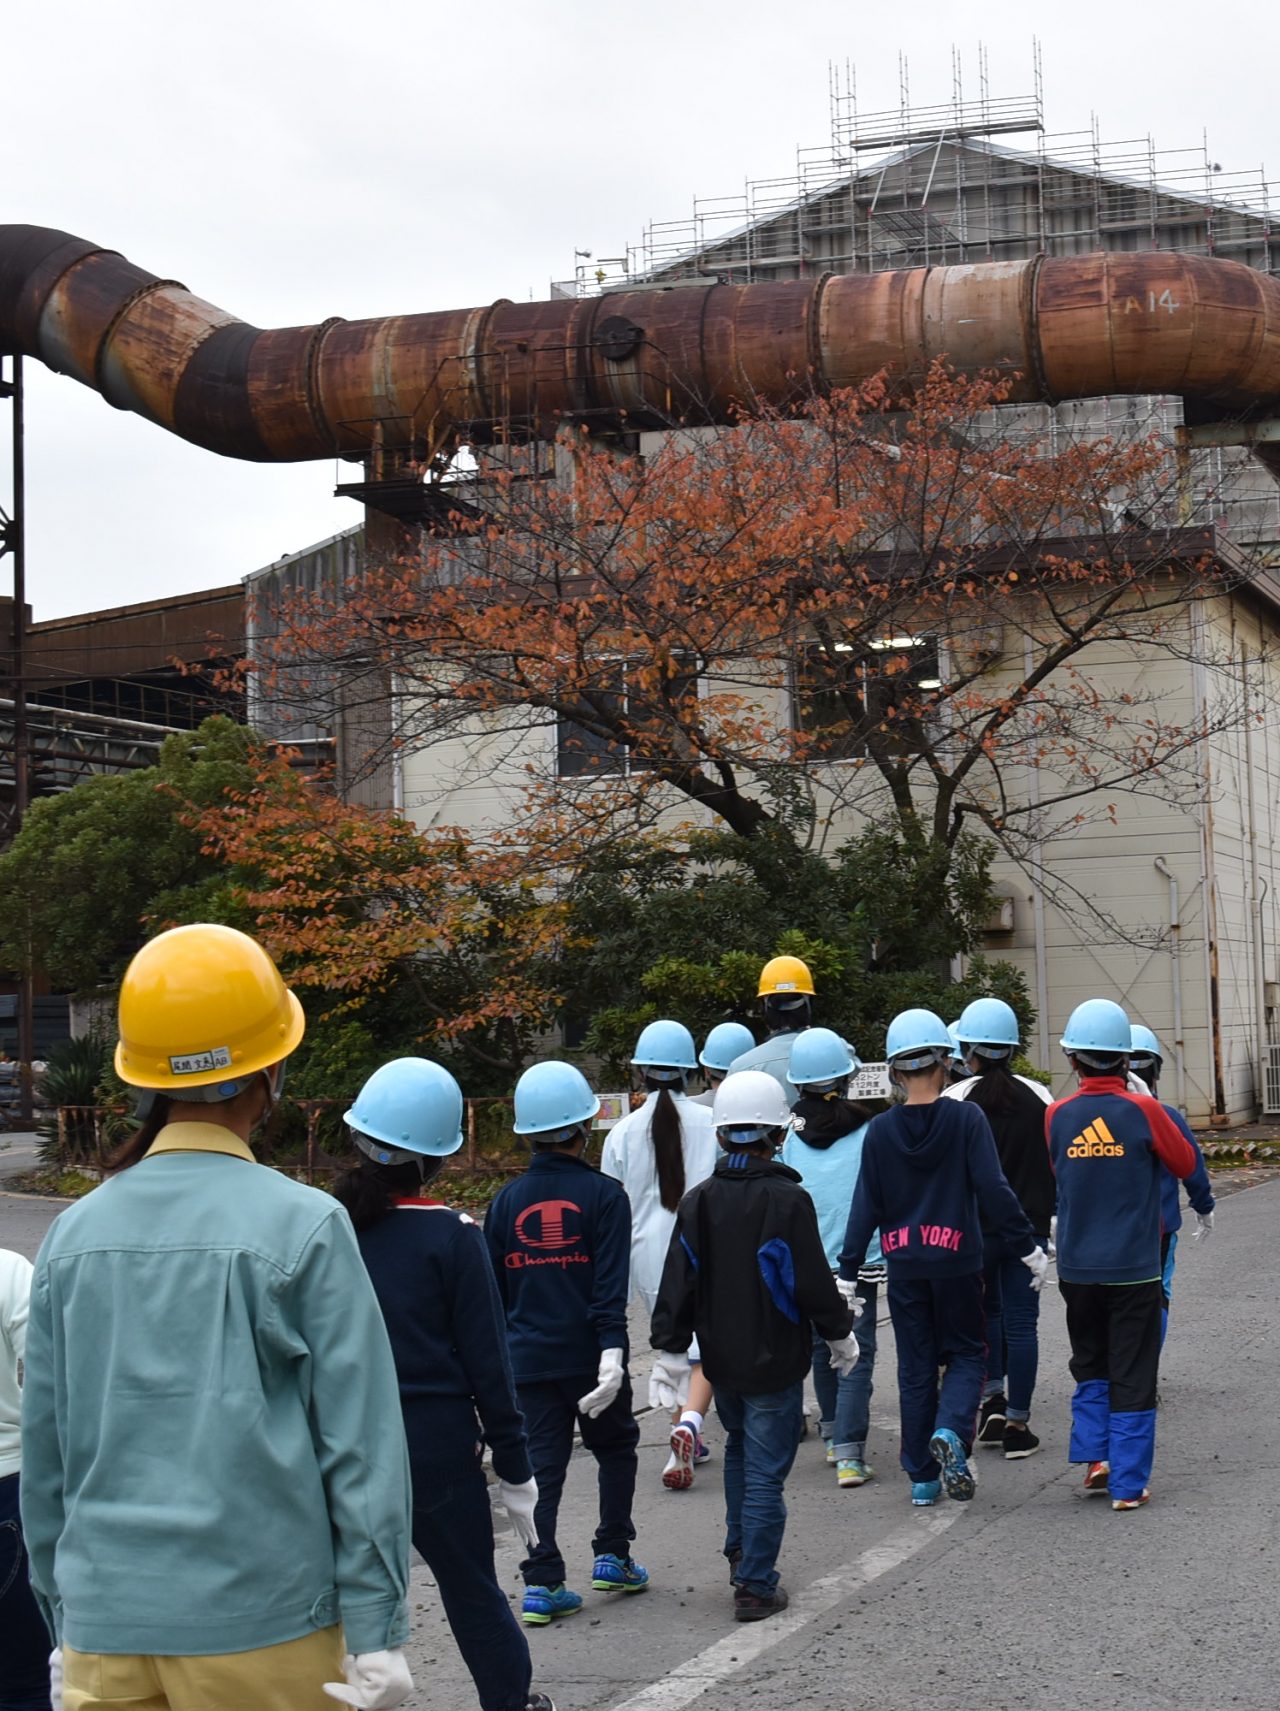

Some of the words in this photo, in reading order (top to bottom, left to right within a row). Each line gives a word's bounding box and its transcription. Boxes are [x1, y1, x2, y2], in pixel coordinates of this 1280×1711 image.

[1149, 288, 1180, 313] 14
[1066, 1142, 1125, 1159] adidas
[881, 1226, 909, 1255] NEW
[919, 1225, 964, 1252] YORK
[504, 1251, 590, 1270] Champio
